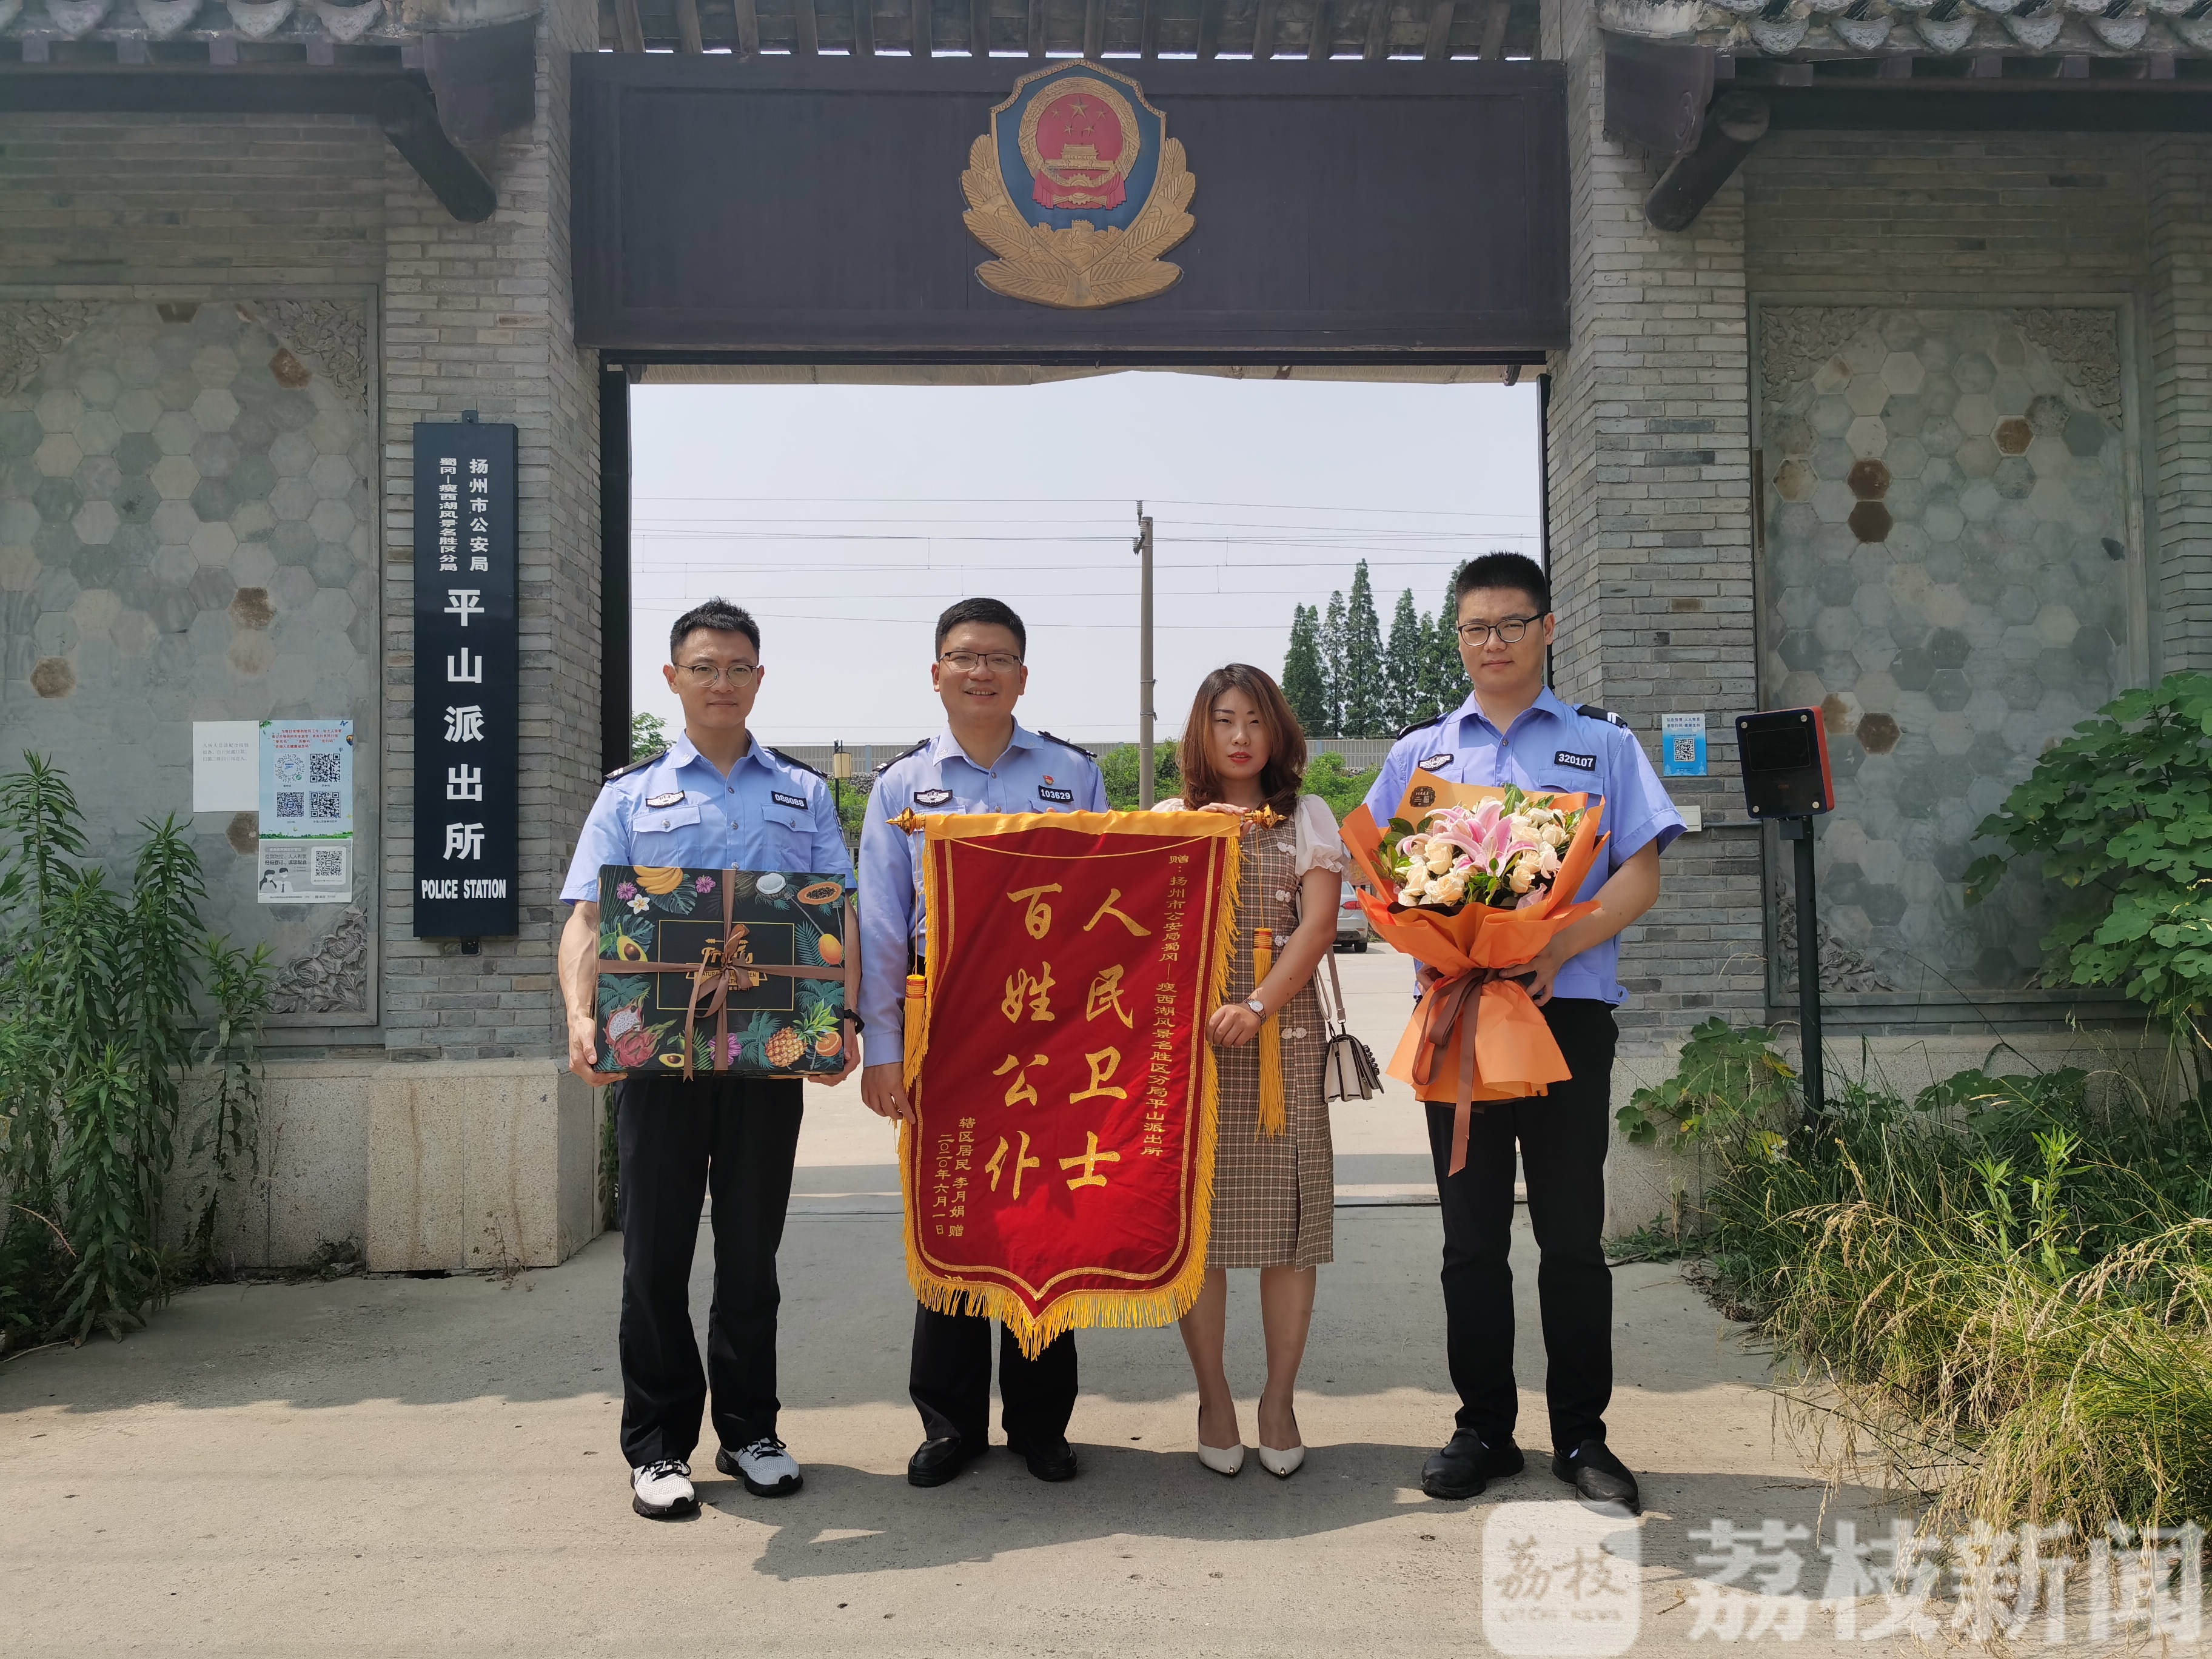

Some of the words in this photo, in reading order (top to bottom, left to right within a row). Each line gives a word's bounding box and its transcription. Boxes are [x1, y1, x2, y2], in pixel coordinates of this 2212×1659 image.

[469, 458, 489, 572] 扬州市公安局
[443, 589, 484, 860] 平山派出所
[1558, 753, 1594, 768] 320107
[774, 794, 805, 807] 088088
[1041, 789, 1071, 800] 103629
[421, 879, 458, 899] POLICE
[463, 879, 506, 899] STATION
[985, 882, 1063, 1201] 百姓公仆
[1058, 887, 1151, 1191] 人民卫士
[955, 1117, 976, 1170] 辖区居民
[949, 1177, 969, 1218] 李月娟
[948, 1224, 964, 1237] 赠
